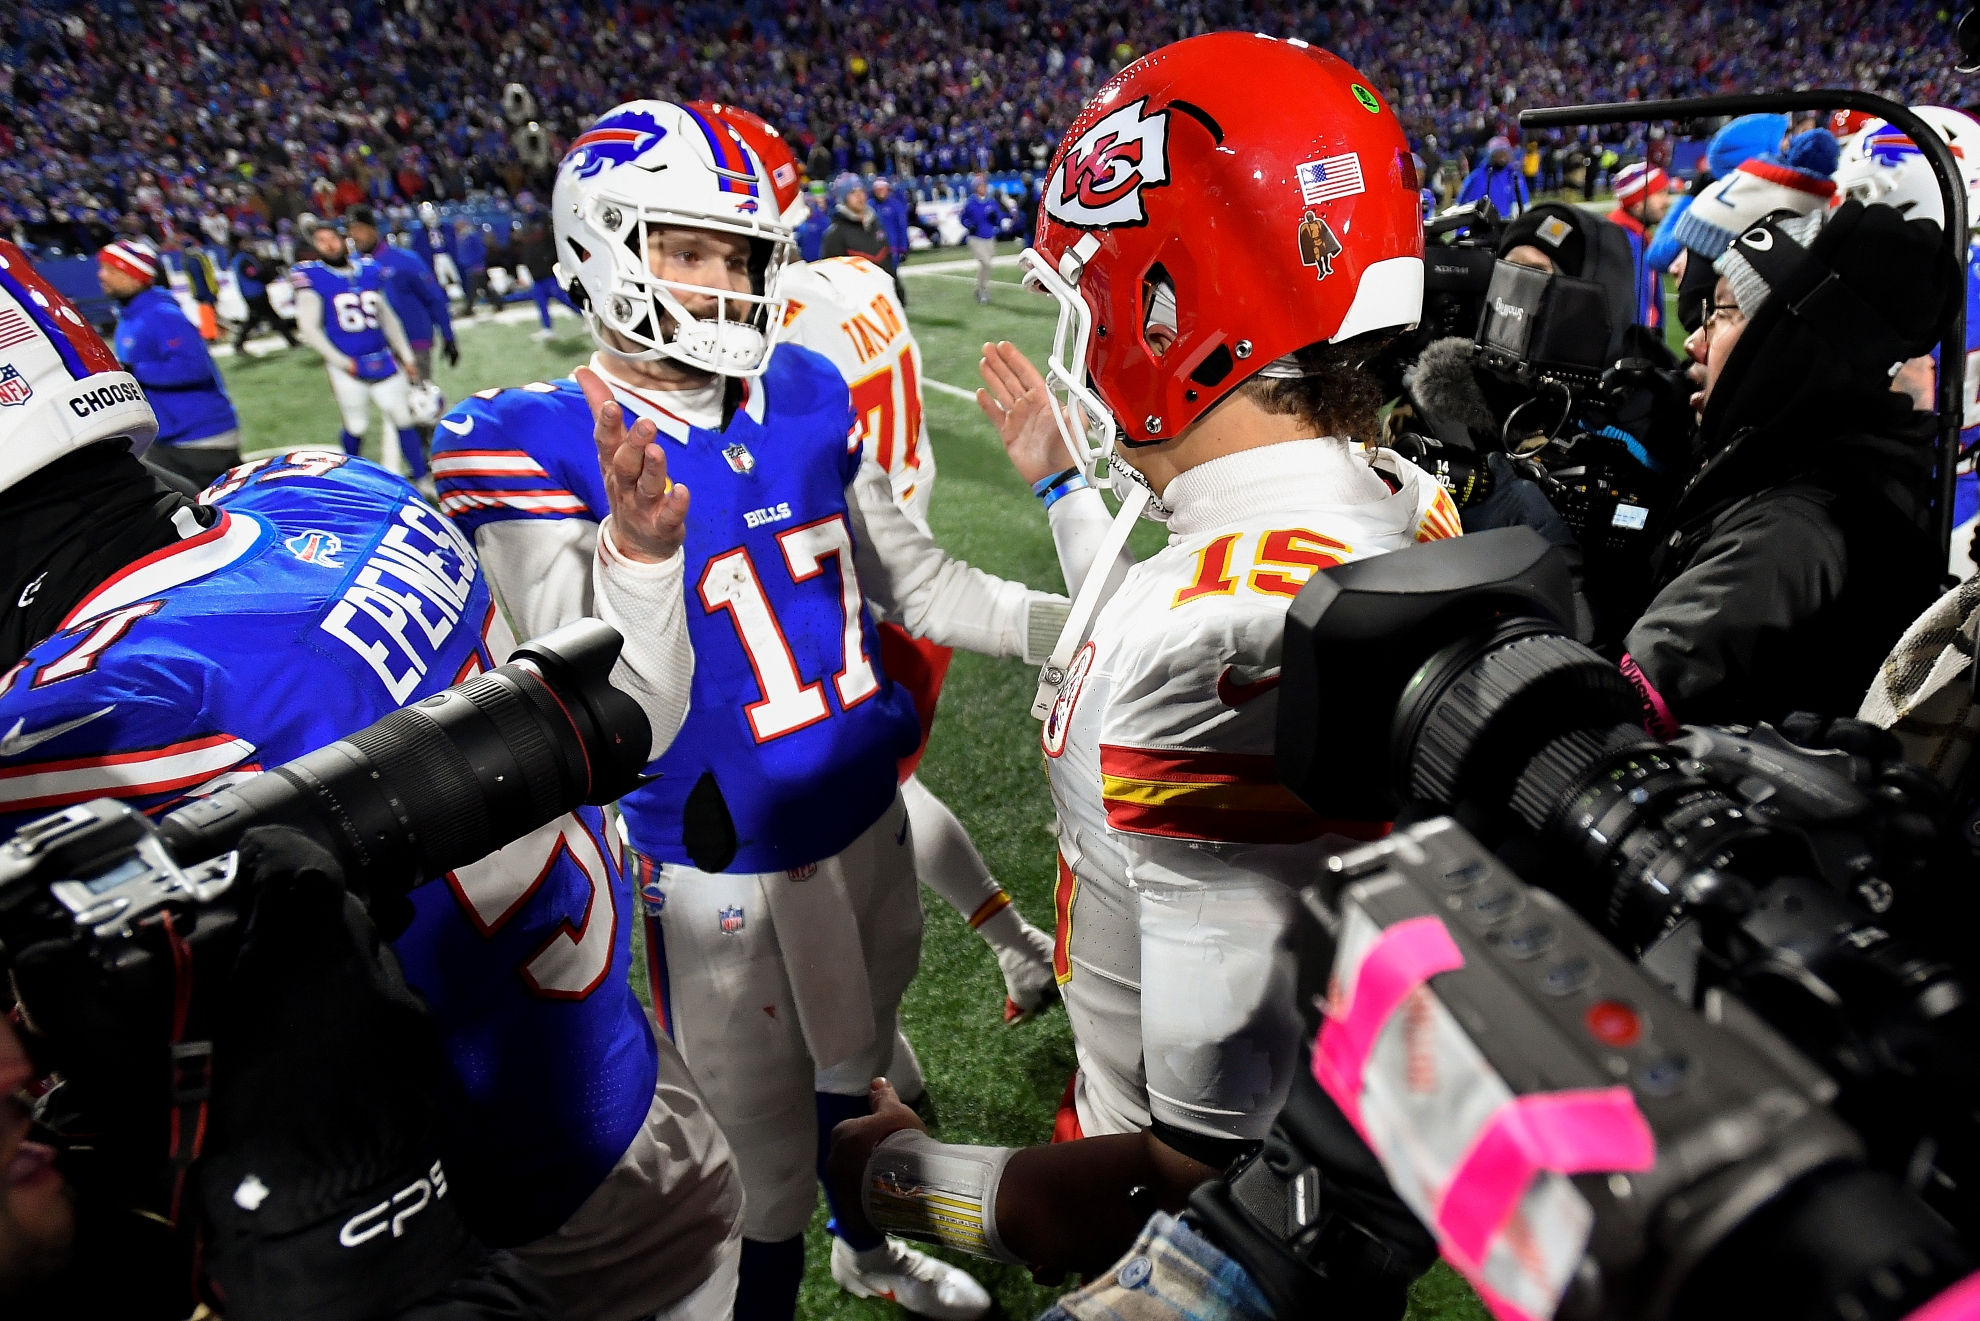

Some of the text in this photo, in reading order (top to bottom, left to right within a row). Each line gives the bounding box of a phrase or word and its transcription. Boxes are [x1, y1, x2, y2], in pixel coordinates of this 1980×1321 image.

[69, 382, 142, 418] CHOOSE
[743, 502, 792, 529] BILLS
[1170, 527, 1353, 610] 15
[696, 512, 881, 745] 17
